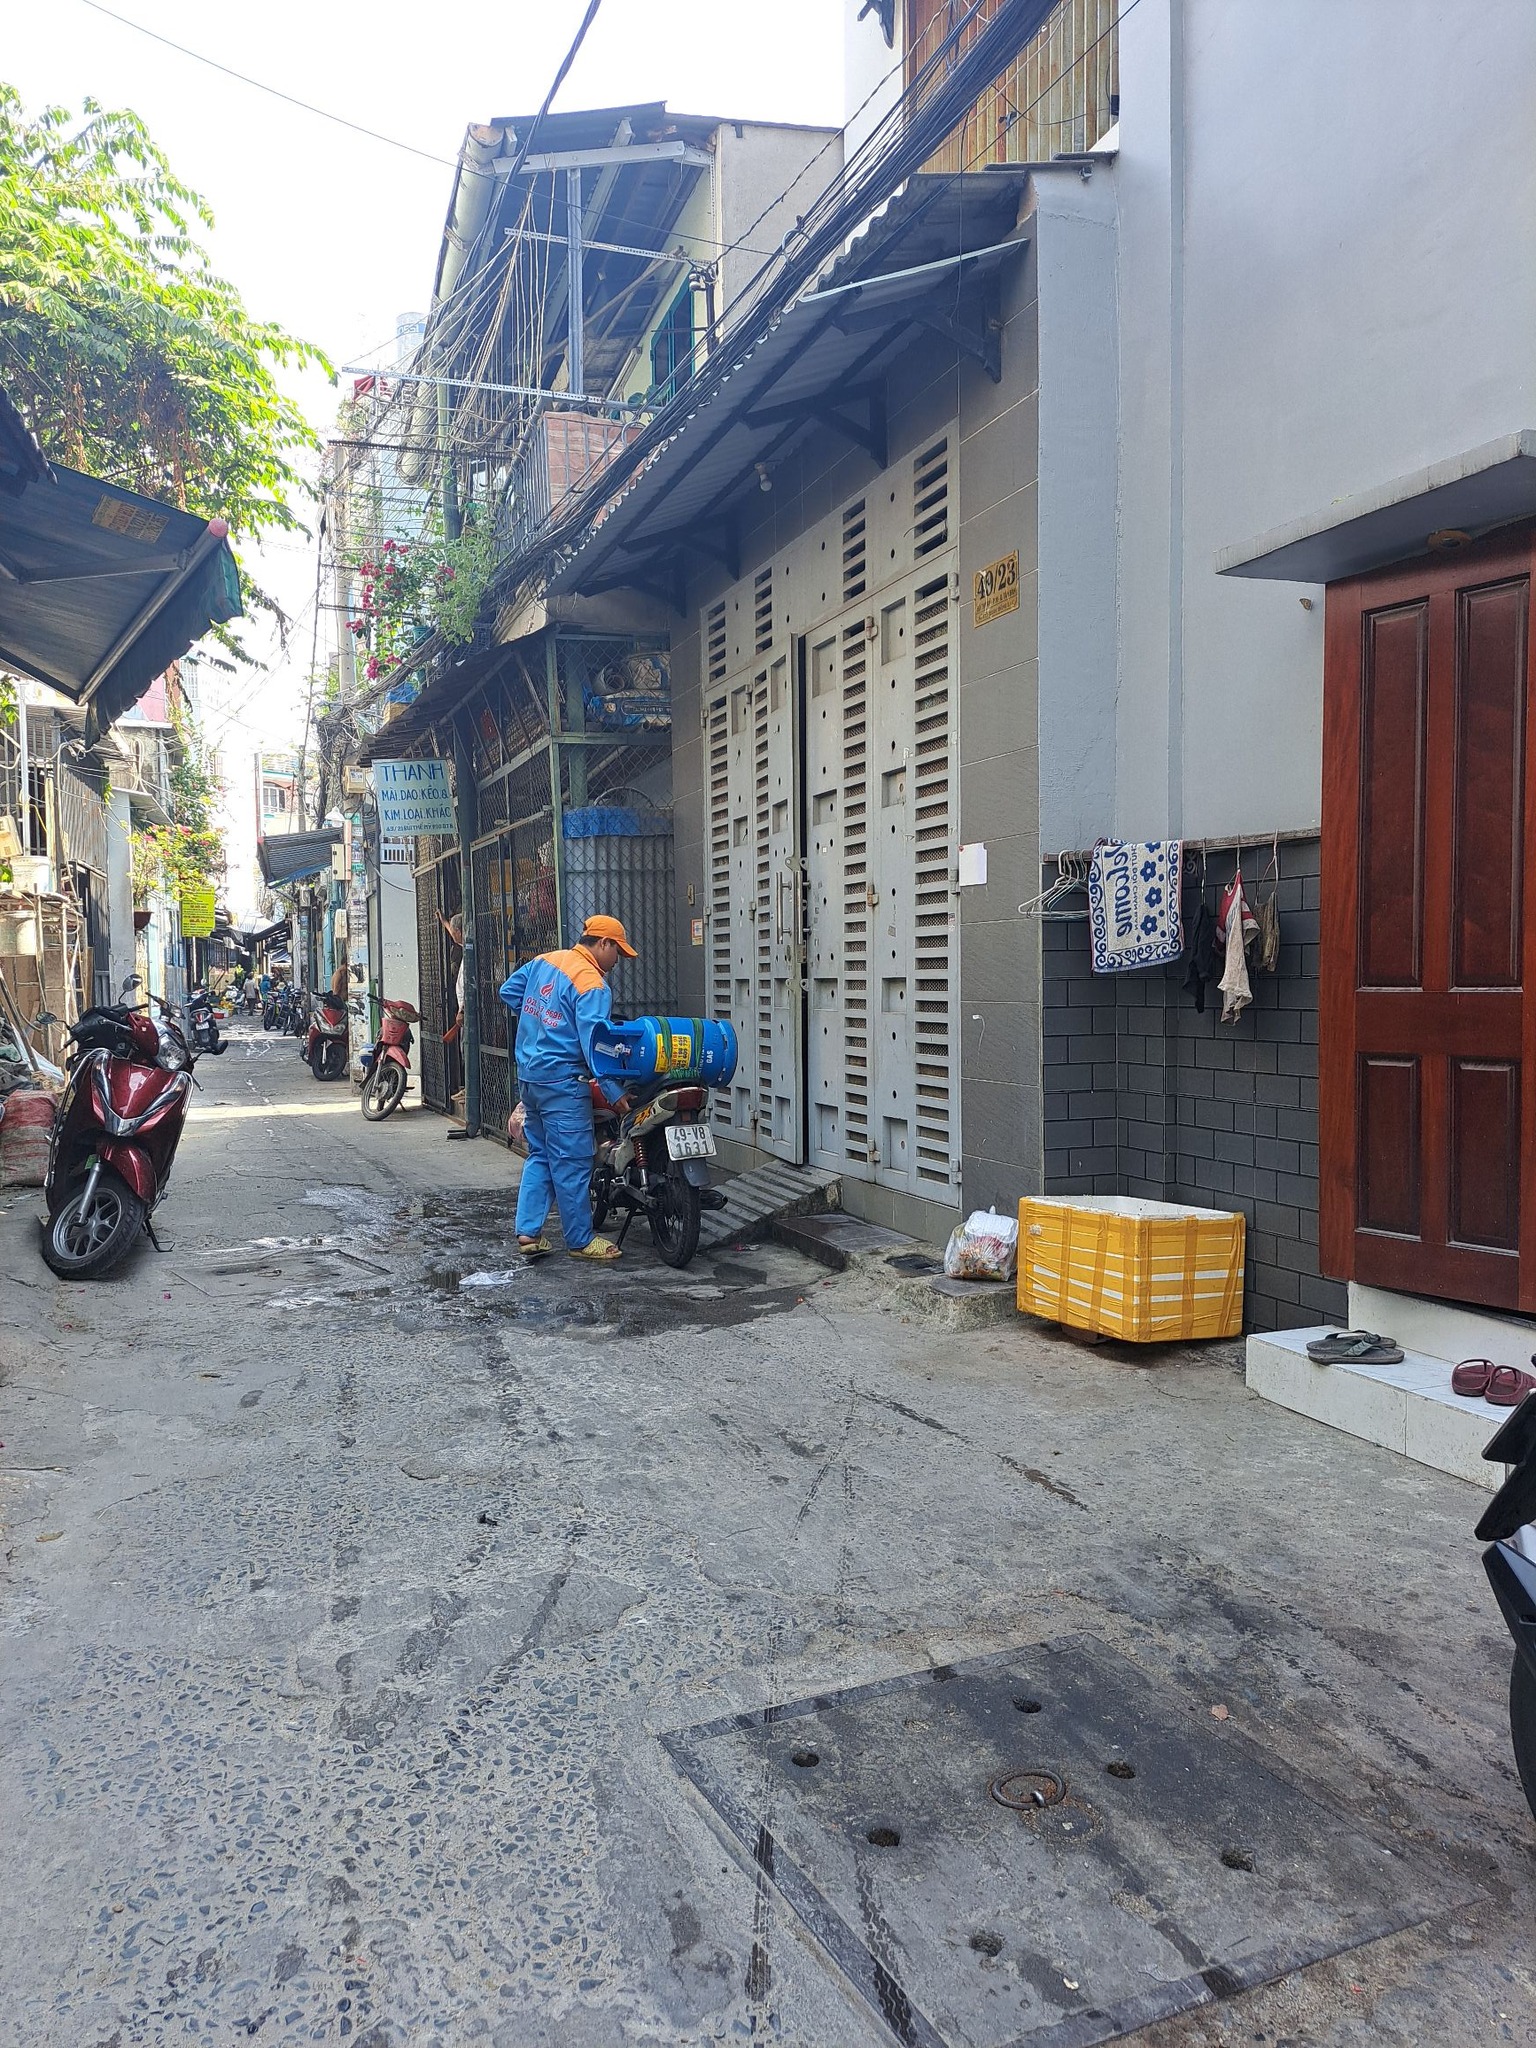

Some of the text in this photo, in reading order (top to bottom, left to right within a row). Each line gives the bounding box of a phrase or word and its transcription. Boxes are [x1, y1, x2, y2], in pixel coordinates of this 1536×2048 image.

[977, 559, 1016, 600] 49/23
[381, 763, 444, 781] THANH
[706, 1050, 714, 1064] GAS
[674, 1126, 706, 1142] 49-V8
[676, 1141, 709, 1157] 1631
